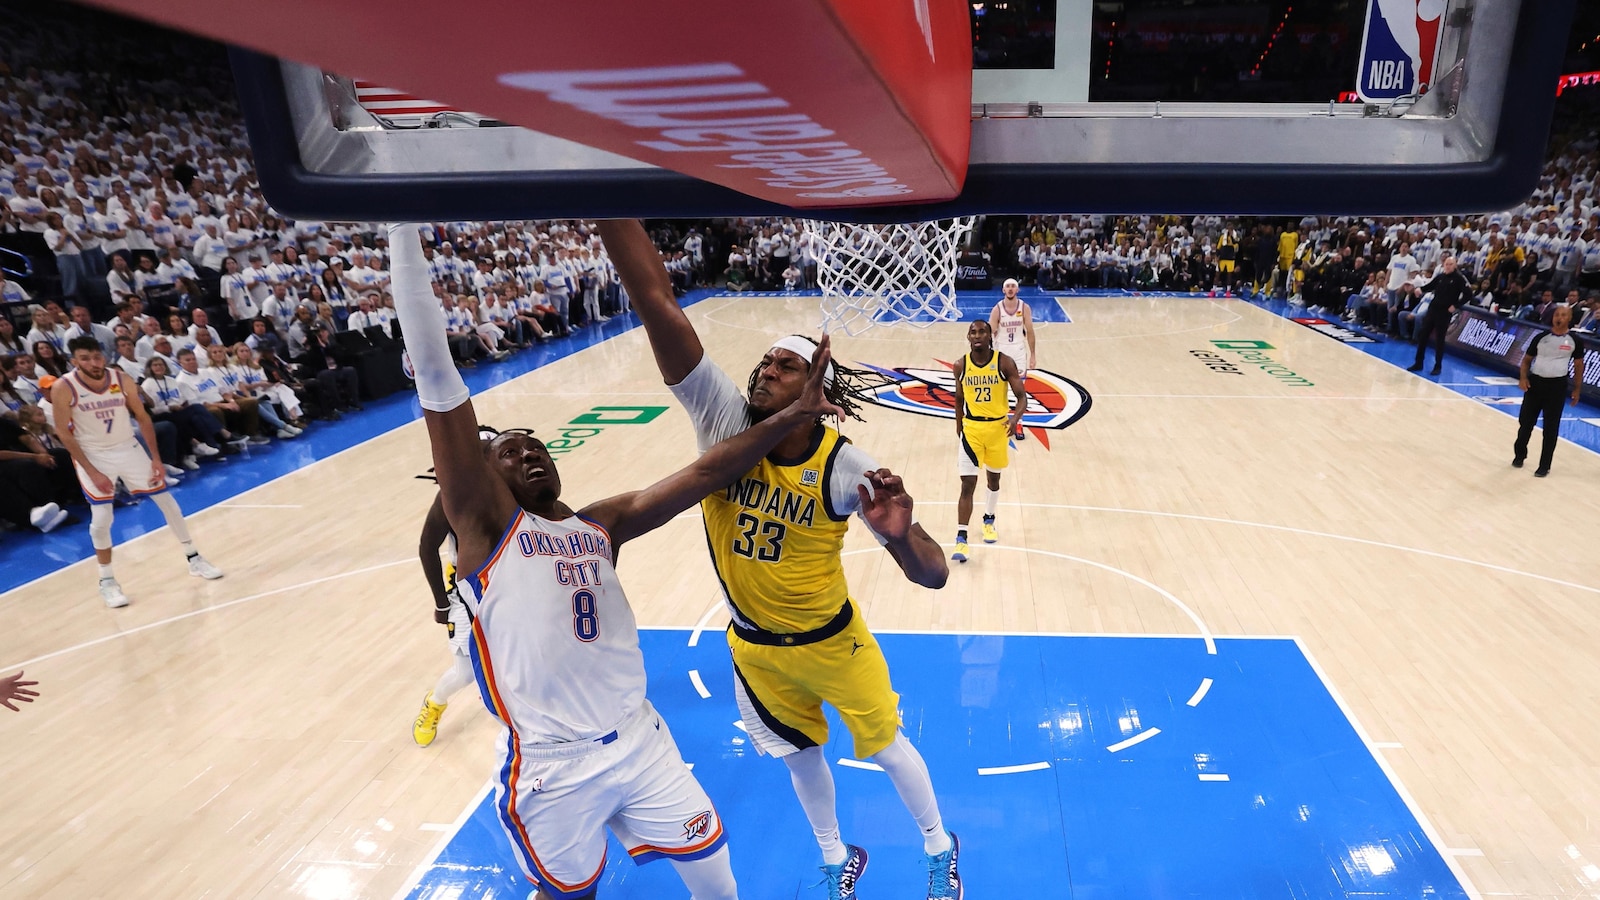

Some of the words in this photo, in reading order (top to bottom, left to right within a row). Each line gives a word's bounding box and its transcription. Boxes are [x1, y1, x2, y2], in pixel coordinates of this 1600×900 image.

[1368, 60, 1405, 90] NBA
[1008, 333, 1014, 343] 9
[965, 375, 999, 386] INDIANA
[1226, 350, 1315, 386] paycom
[974, 387, 991, 403] 23
[103, 418, 113, 434] 7
[733, 512, 787, 564] 33
[555, 560, 601, 587] CITY
[572, 588, 600, 643] 8
